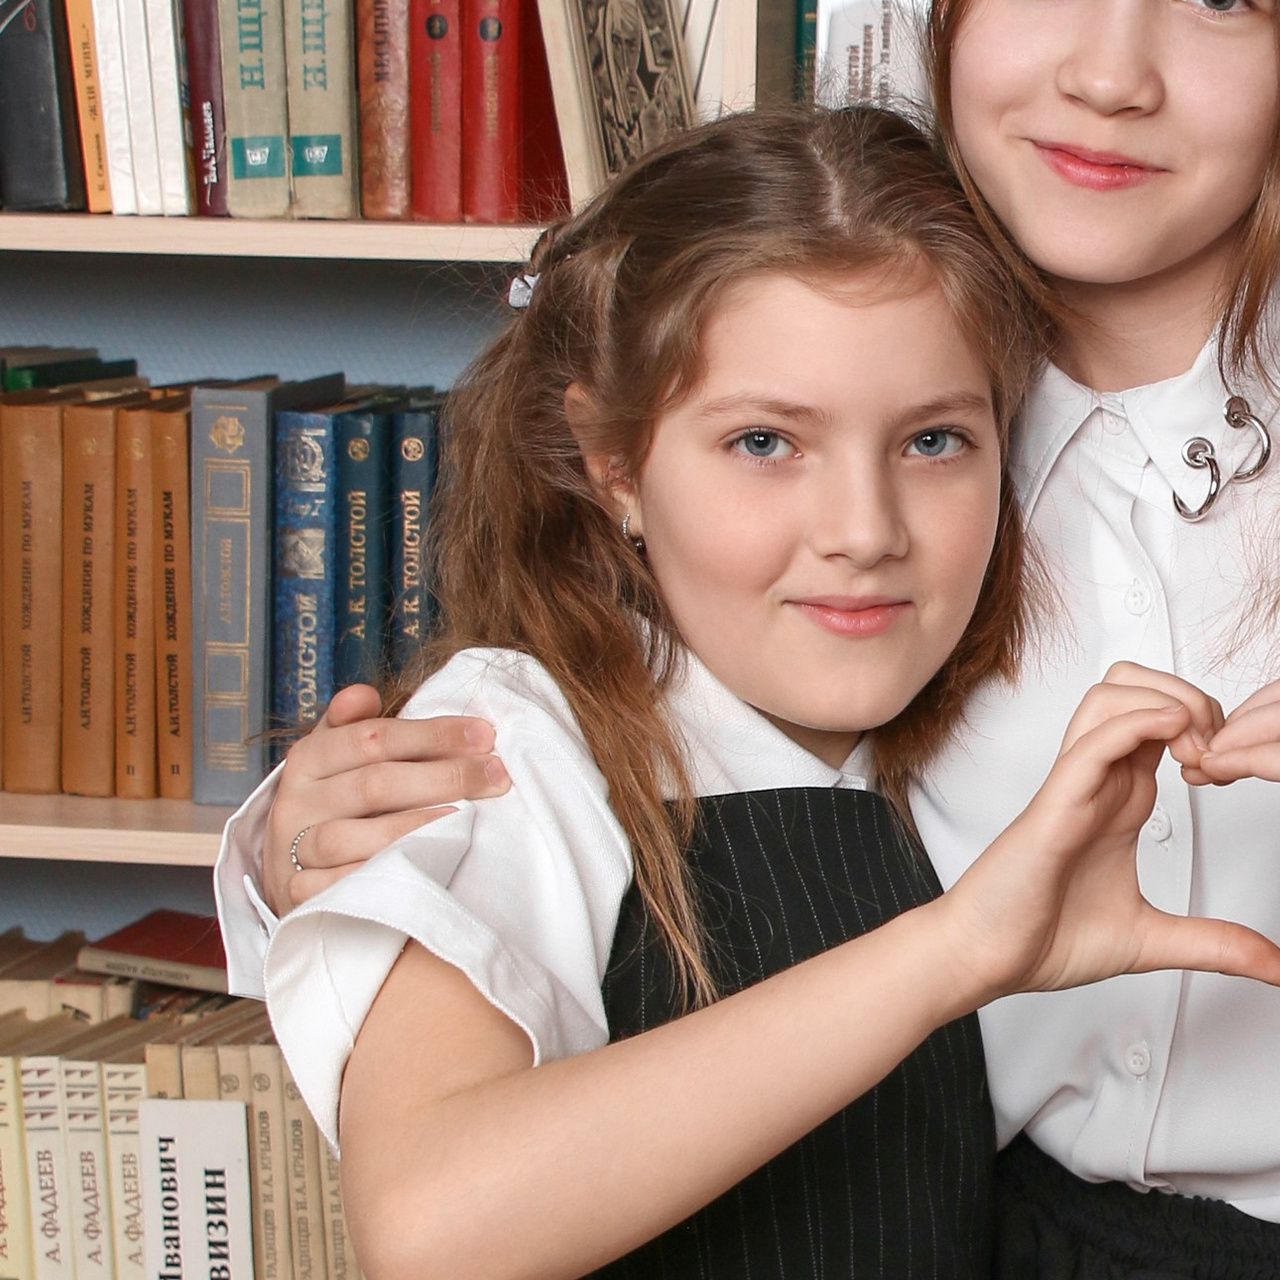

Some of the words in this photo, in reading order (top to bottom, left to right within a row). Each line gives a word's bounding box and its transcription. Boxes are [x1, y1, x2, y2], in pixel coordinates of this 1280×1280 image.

[22, 481, 32, 531] МУКАМ
[84, 483, 95, 535] МУКАМ
[128, 489, 138, 537] МУКАМ
[163, 490, 174, 536] МУКАМ
[23, 535, 32, 560] ПО
[83, 538, 93, 562] ПО
[128, 541, 137, 564] ПО
[164, 540, 175, 563] ПО
[348, 490, 367, 595] ТОЛСТОЙ
[402, 490, 420, 591] ТОЛСТОЙ
[22, 564, 33, 630] ХОЖДЕНИЕ
[82, 568, 93, 634] ХОЖДЕНИЕ
[127, 569, 138, 639] ХОЖДЕНИЕ
[166, 568, 178, 640] ХОЖДЕНИЕ
[259, 1110, 272, 1173] КРЫЛОВ
[292, 1120, 304, 1180] КРЫЛОВ
[37, 1149, 61, 1238] ФАДЕЕВ
[80, 1151, 102, 1238] ФАДЕЕВ
[122, 1153, 143, 1241] ФАДЕЕВ
